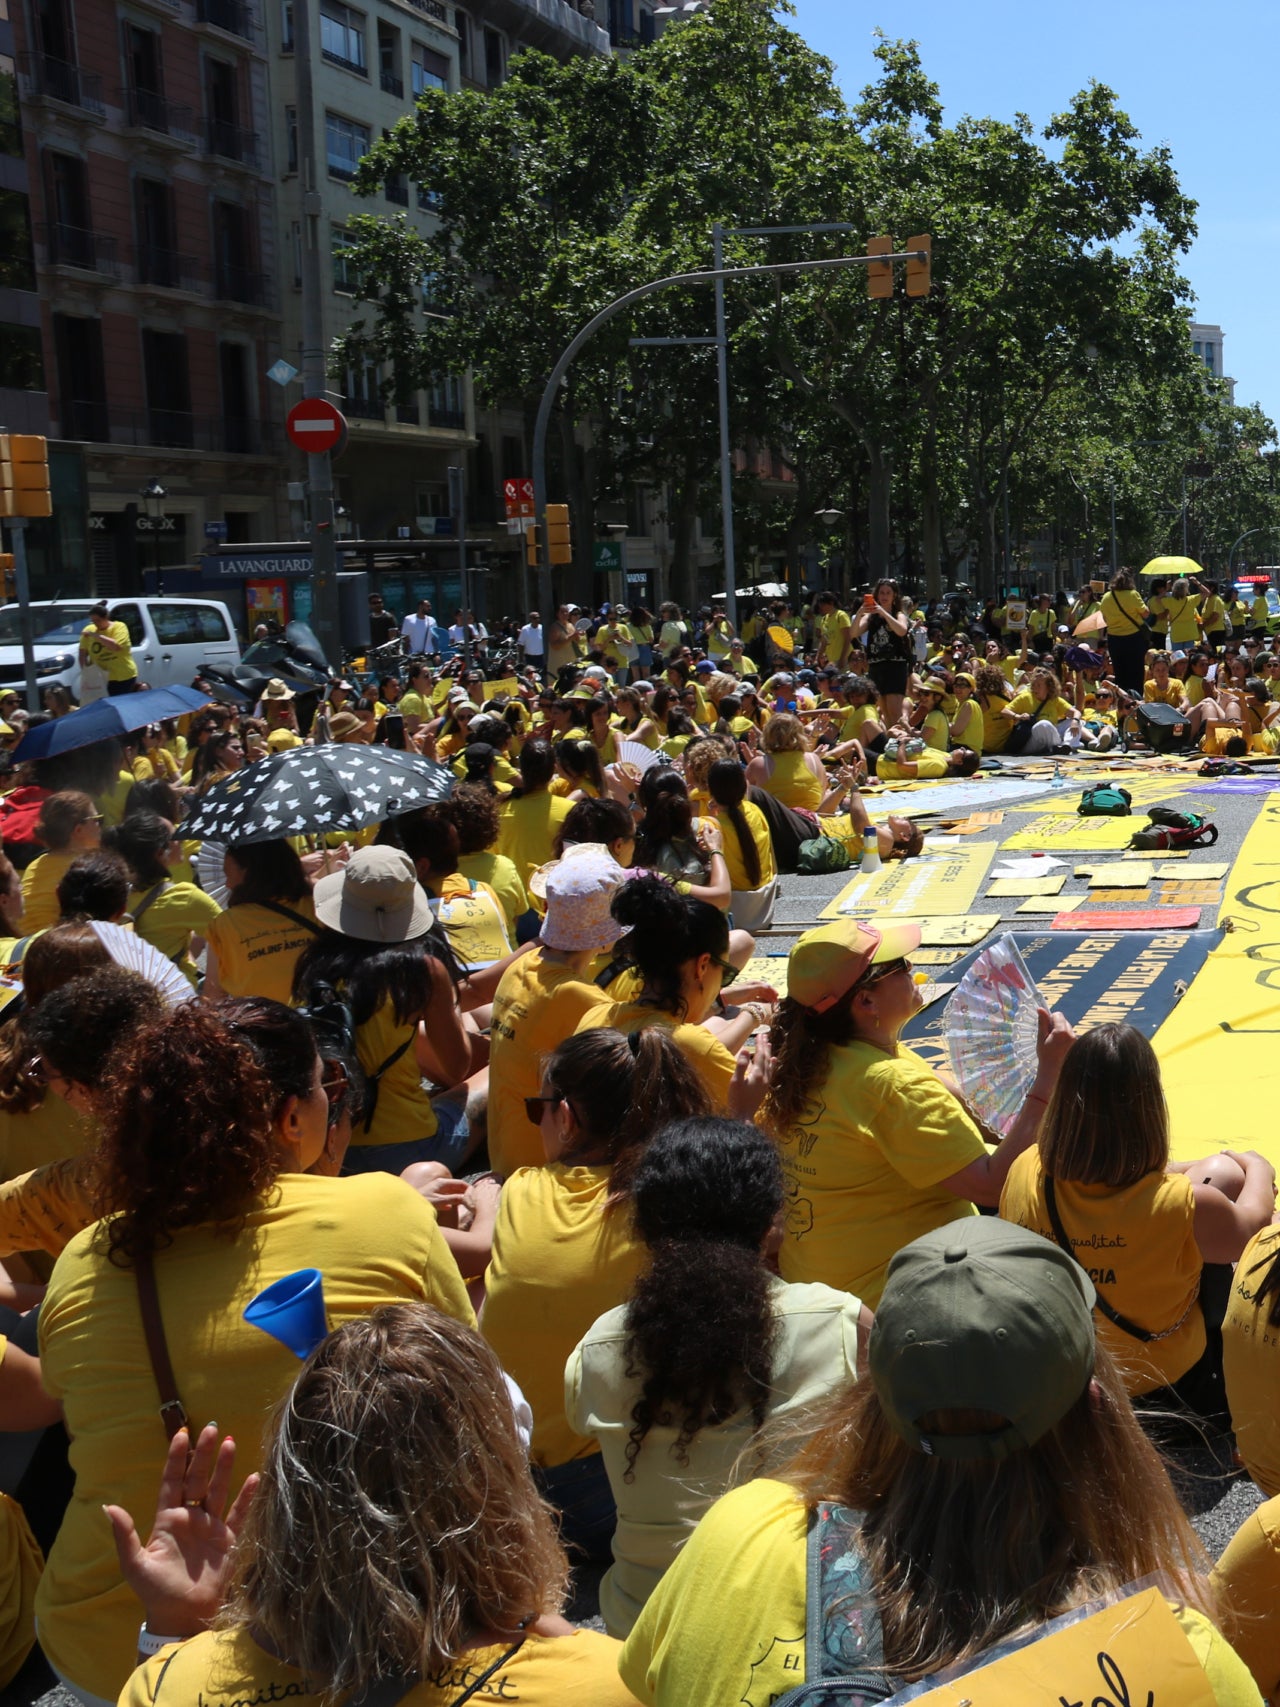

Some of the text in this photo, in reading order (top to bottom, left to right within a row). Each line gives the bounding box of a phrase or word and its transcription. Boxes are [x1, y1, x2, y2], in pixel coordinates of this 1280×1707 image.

[219, 558, 314, 574] LA VANGUARD
[595, 558, 618, 567] adif
[1148, 934, 1190, 950] PER
[1108, 961, 1168, 990] PETITA
[1070, 1234, 1127, 1251] qualitat
[783, 1653, 801, 1671] EL
